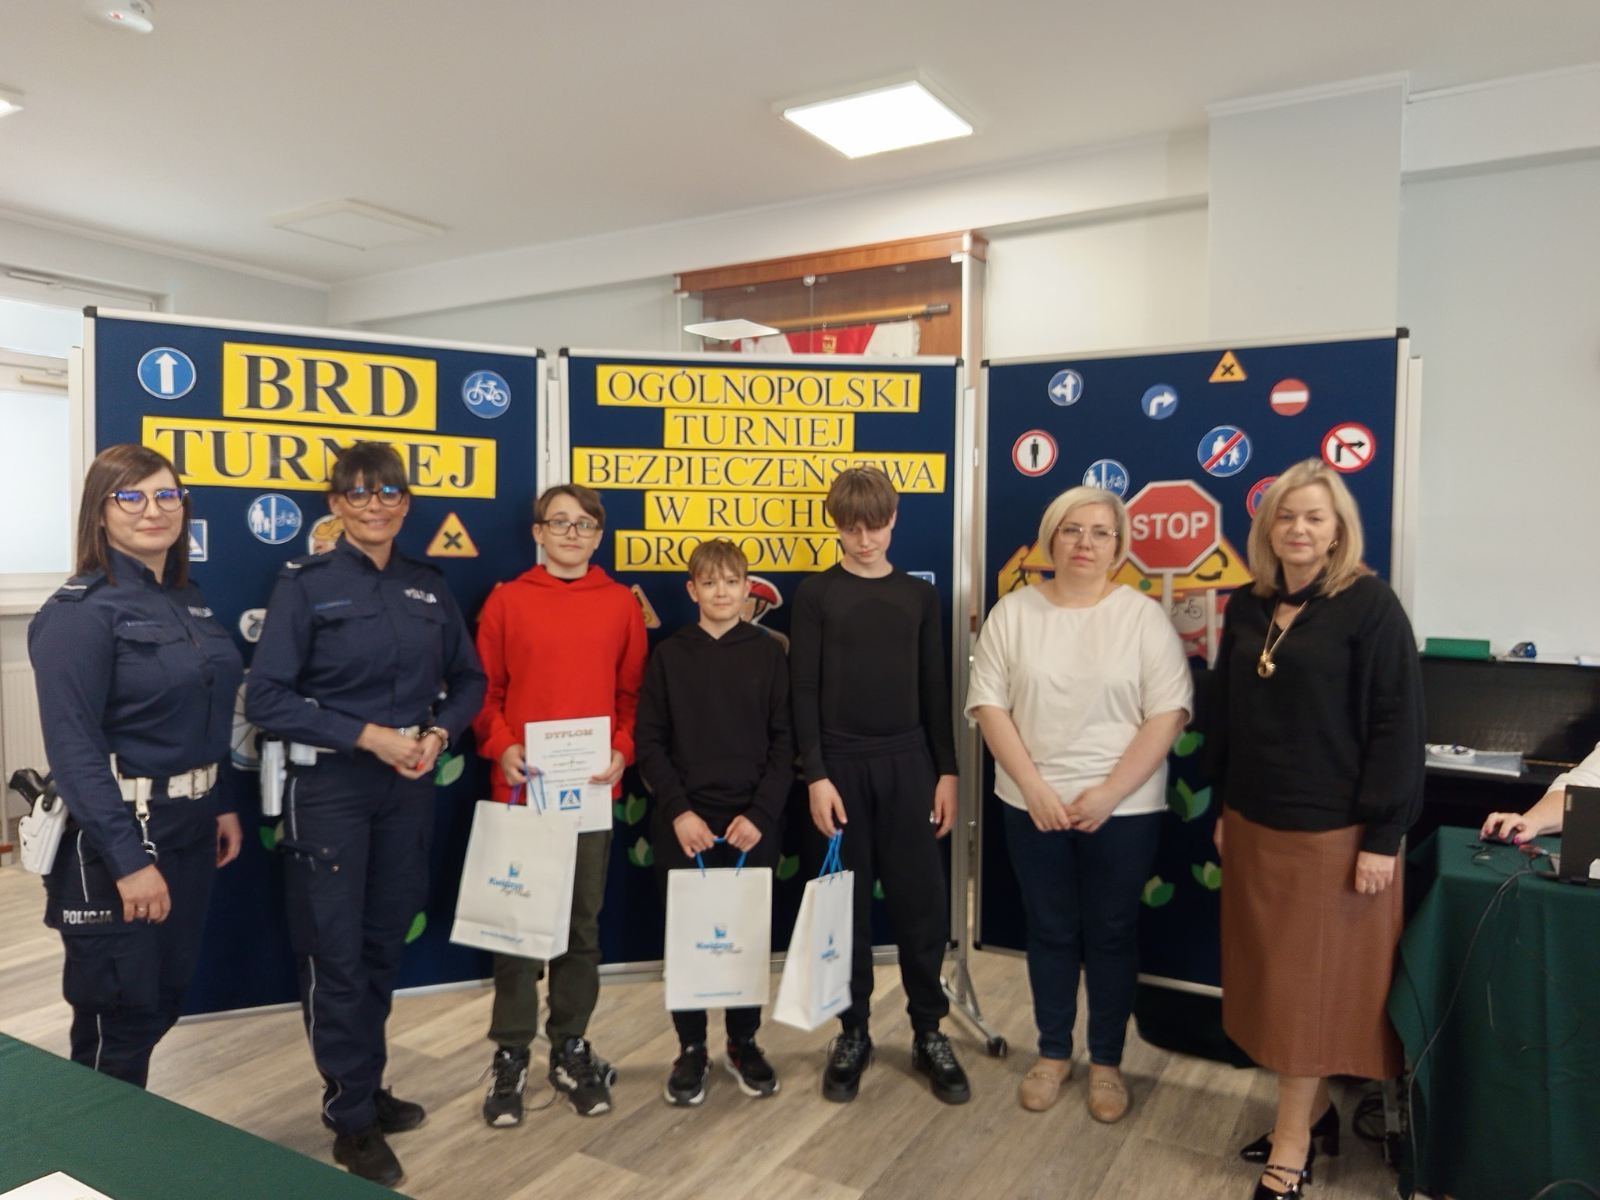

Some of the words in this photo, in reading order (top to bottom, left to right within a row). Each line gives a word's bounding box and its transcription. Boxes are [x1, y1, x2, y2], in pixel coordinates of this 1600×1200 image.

[239, 354, 419, 418] BRD
[607, 369, 913, 408] OGÓLNOPOLSKI
[673, 414, 845, 447] TURNIEJ
[155, 428, 479, 489] TURNEJ
[655, 495, 690, 525] W
[1131, 510, 1209, 541] STOP
[624, 535, 847, 567] DROOWY
[544, 728, 593, 740] DYPLOM
[63, 909, 112, 924] POLICJA
